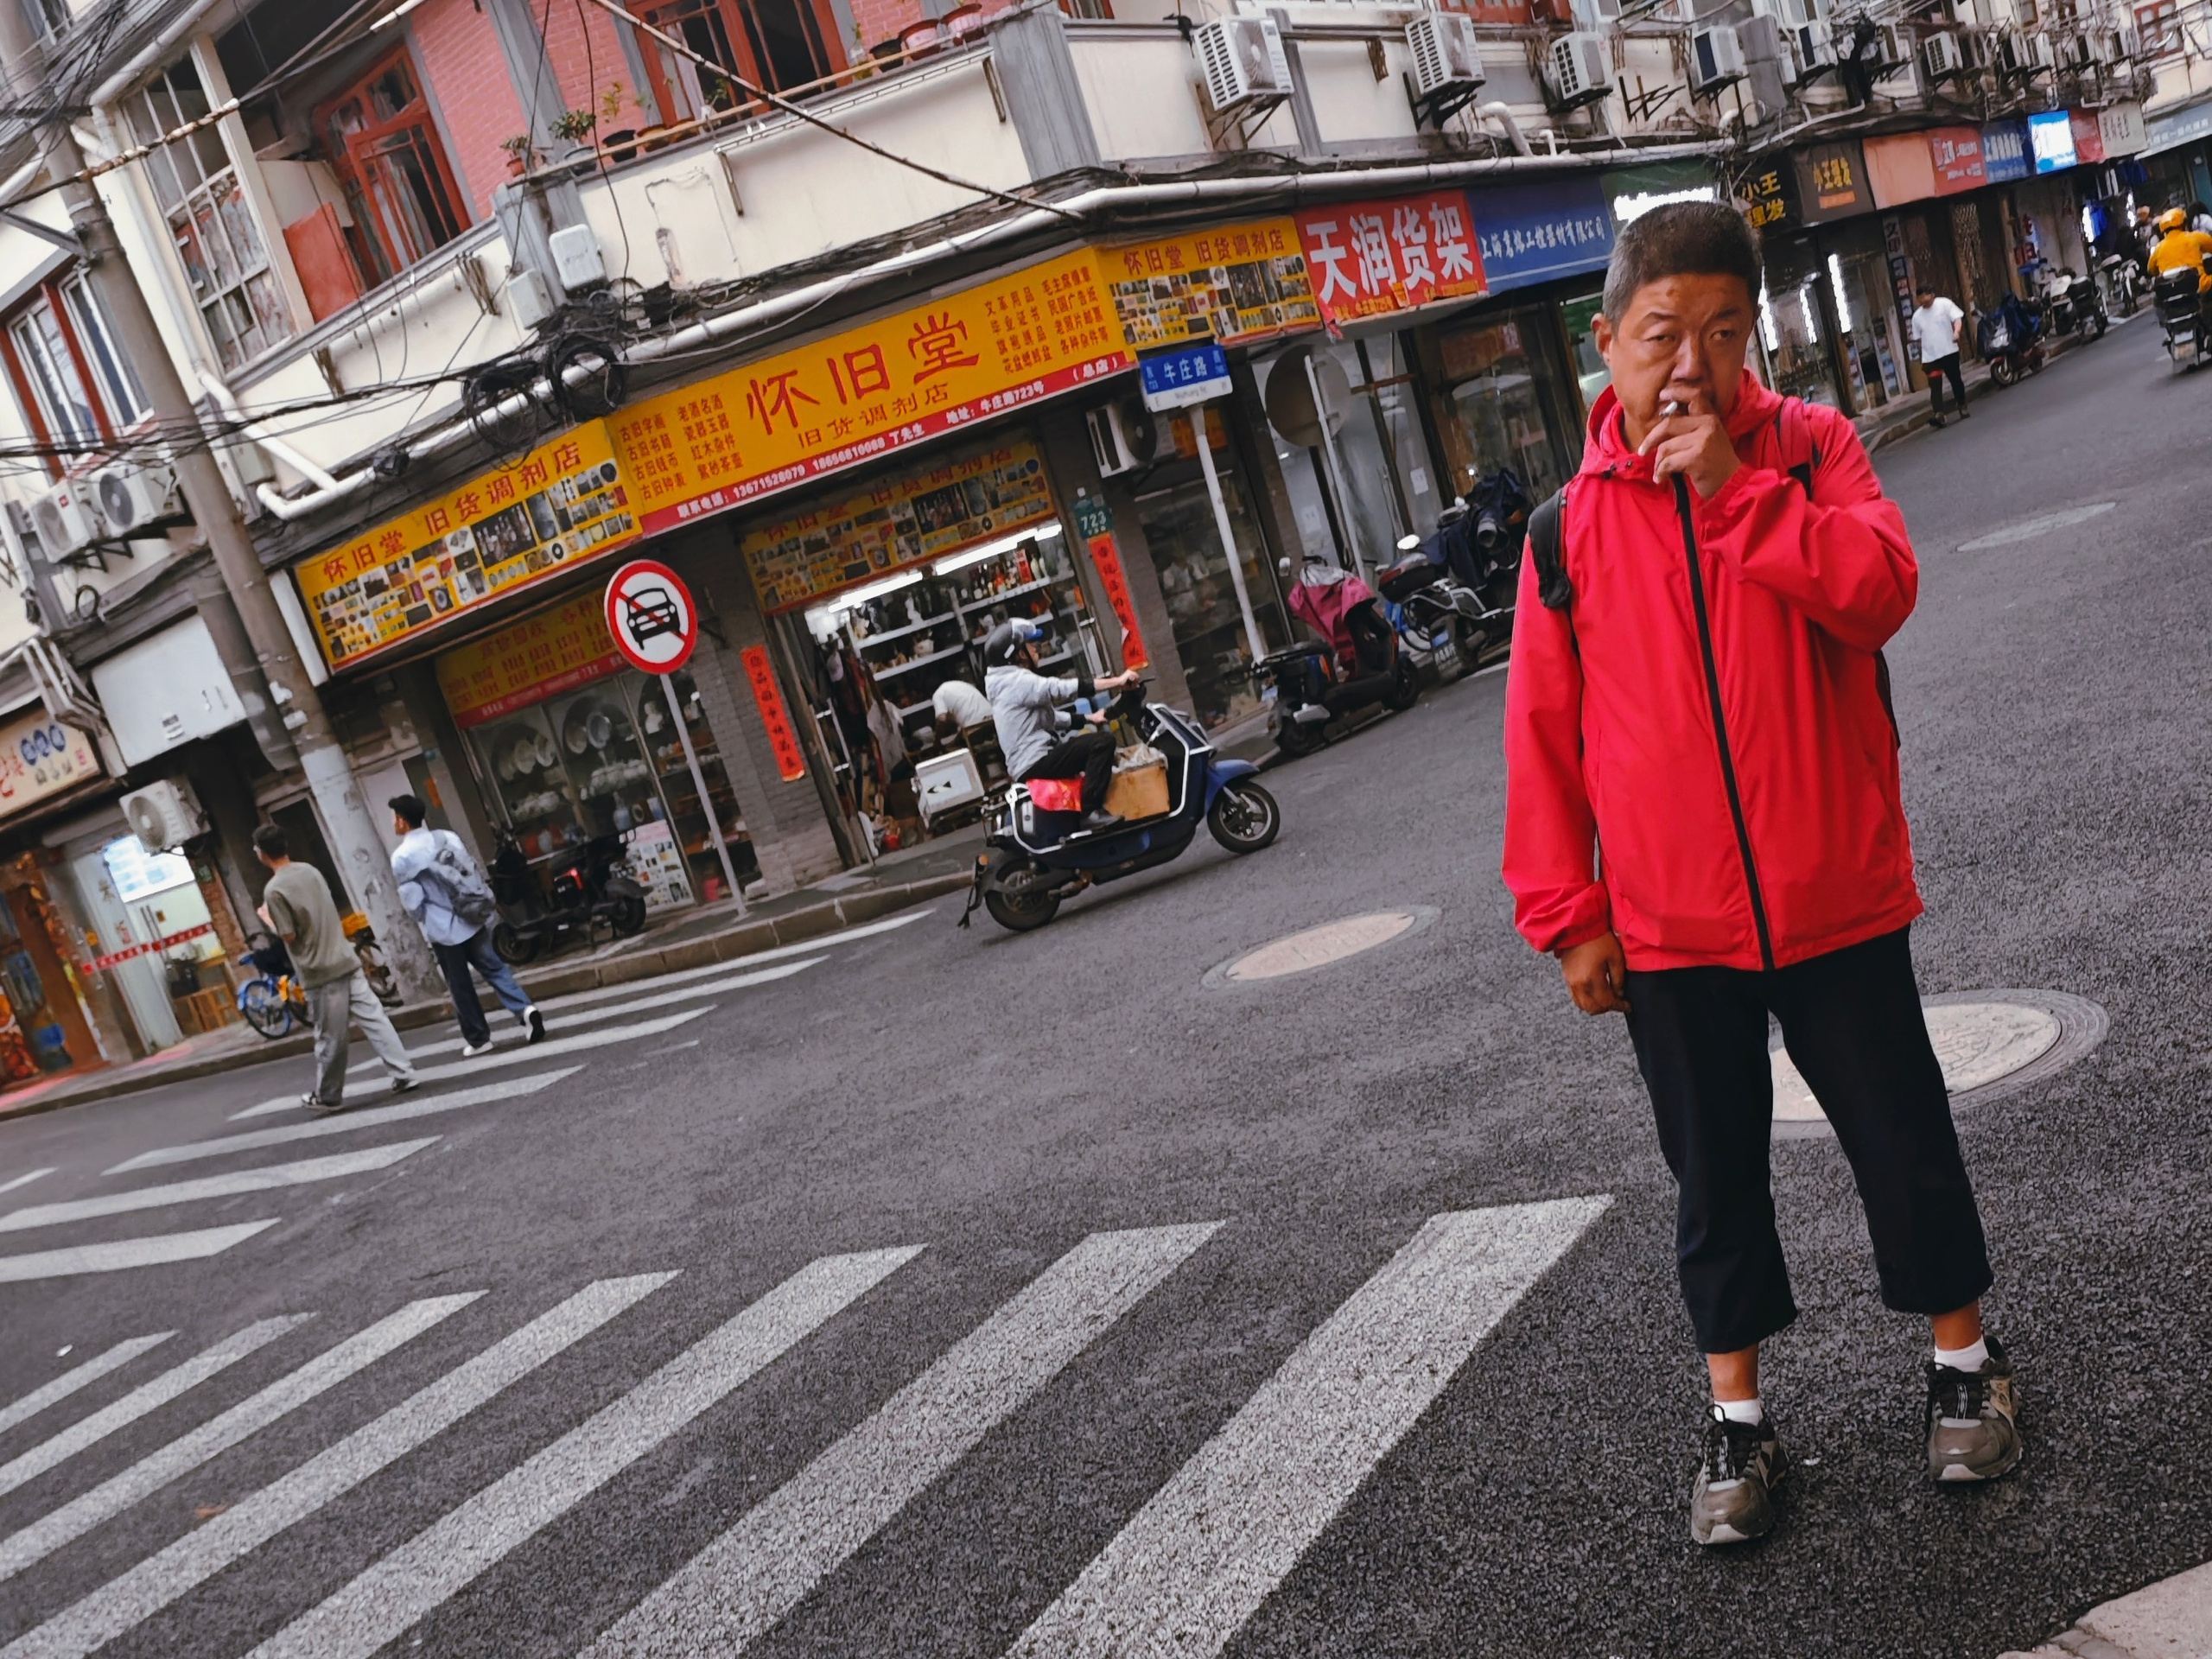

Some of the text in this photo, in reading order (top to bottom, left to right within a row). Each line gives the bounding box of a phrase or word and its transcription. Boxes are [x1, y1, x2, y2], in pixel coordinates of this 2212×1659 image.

[1741, 170, 1781, 201] 小王
[1123, 228, 1285, 276] 怀旧堂 旧货调剂店
[1306, 202, 1473, 303] 天润货架
[984, 286, 1035, 317] 文革用品
[990, 305, 1040, 334] 毕业证书
[747, 311, 979, 435] 怀旧堂
[1163, 355, 1207, 385] 牛庄路
[620, 412, 666, 443] 古旧字画
[797, 382, 949, 448] 旧货调剂店
[626, 433, 672, 462] 古旧书籍
[633, 452, 678, 481] 古旧钱币
[323, 441, 582, 583] 怀旧堂 旧货调剂店
[1081, 511, 1107, 531] 723
